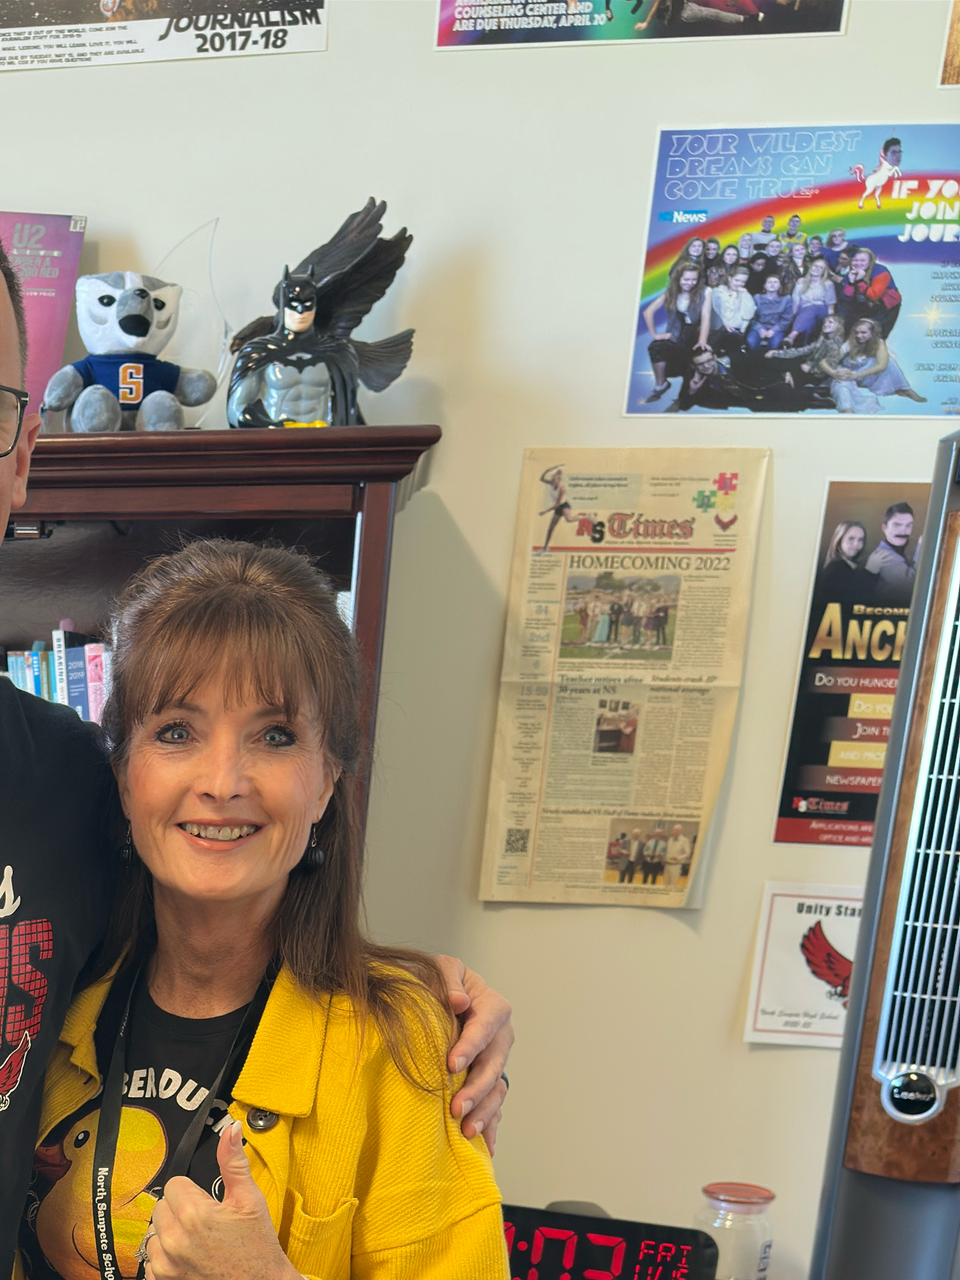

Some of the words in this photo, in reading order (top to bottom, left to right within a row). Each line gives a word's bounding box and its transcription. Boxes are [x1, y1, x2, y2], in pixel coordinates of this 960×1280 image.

[453, 19, 474, 31] ARE
[476, 18, 498, 30] DUE
[500, 15, 557, 29] THURSDAY,
[558, 14, 591, 27] APRIL
[592, 13, 607, 26] 20
[454, 5, 524, 19] COUNSELING
[525, 3, 567, 16] CENTER
[567, 1, 593, 14] AND
[158, 8, 322, 42] JOURNALISM
[195, 28, 288, 53] 2017-18
[670, 134, 739, 156] YOUR
[748, 131, 862, 154] WILDEST
[666, 156, 772, 178] DREAMS
[780, 154, 833, 176] CAN
[664, 179, 738, 201] COME
[891, 179, 919, 199] IF
[905, 201, 960, 220] JOIN
[12, 222, 47, 249] U2
[119, 363, 144, 404] S
[607, 511, 696, 540] Times
[568, 554, 690, 572] HOMECOMING
[695, 554, 730, 572] 2022
[797, 902, 832, 917] Unity
[97, 1167, 110, 1203] North
[97, 1201, 108, 1251] Sanpete
[639, 1240, 692, 1268] FRI
